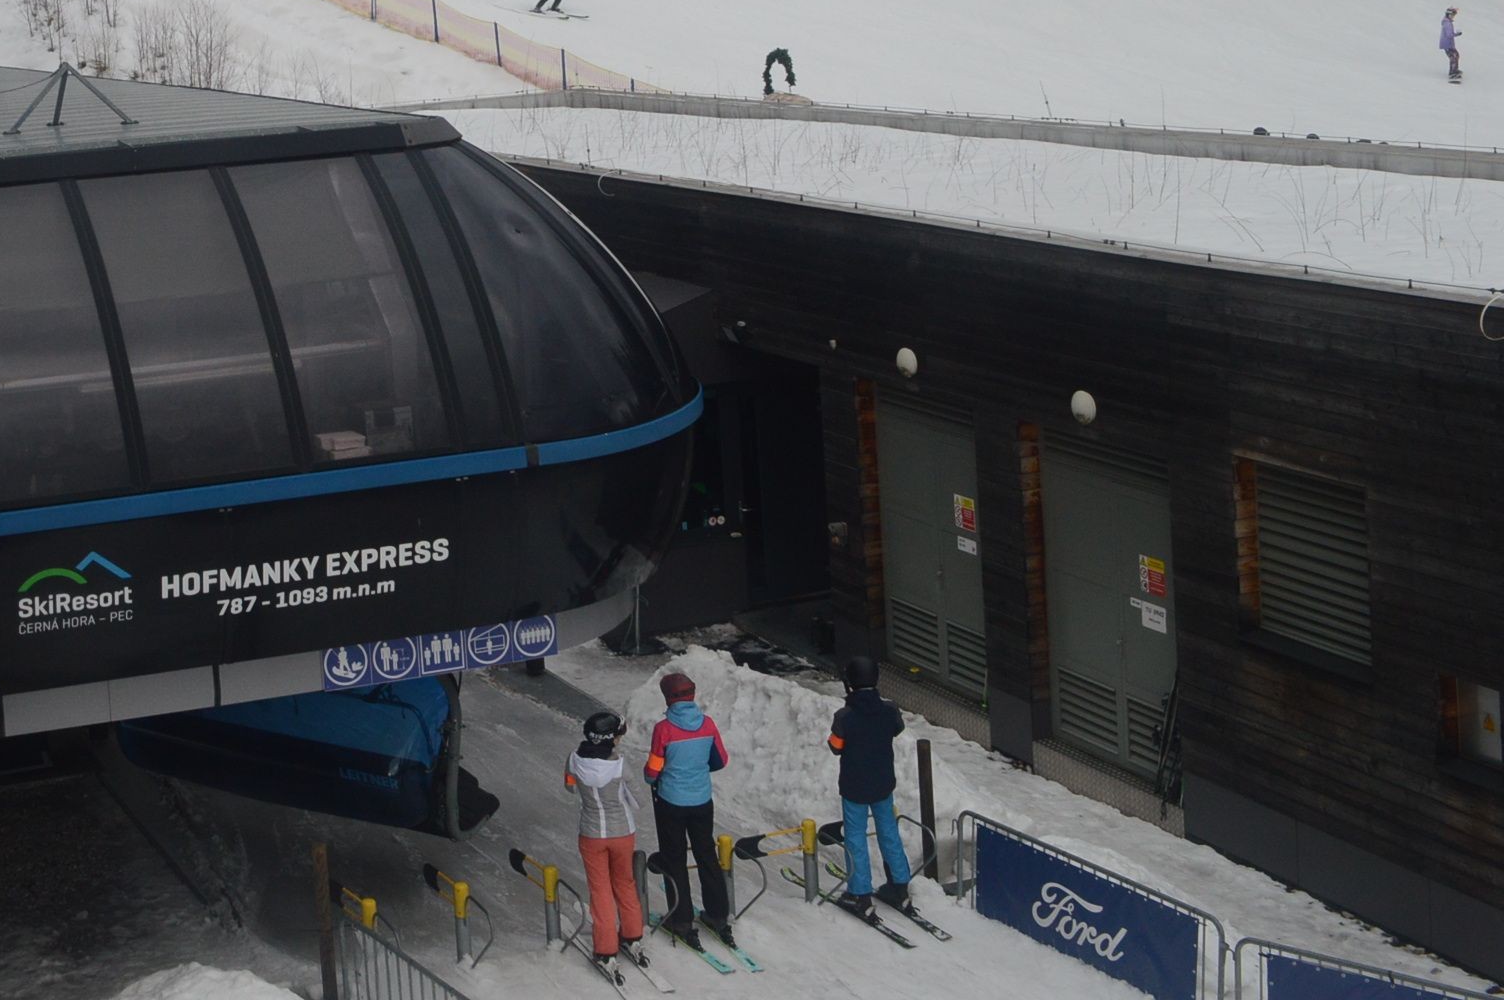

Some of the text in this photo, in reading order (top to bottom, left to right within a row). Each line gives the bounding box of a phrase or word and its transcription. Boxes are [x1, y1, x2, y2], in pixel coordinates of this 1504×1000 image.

[160, 537, 450, 600] HOFMANKY EXPRESS
[17, 586, 134, 619] SkiResort
[216, 595, 257, 616] 787
[275, 586, 328, 608] 1093
[332, 579, 396, 601] m.n.m
[18, 617, 60, 635] ČERNÁ
[62, 615, 96, 630] HORA
[109, 609, 134, 623] PEC
[1031, 881, 1128, 962] Ford
